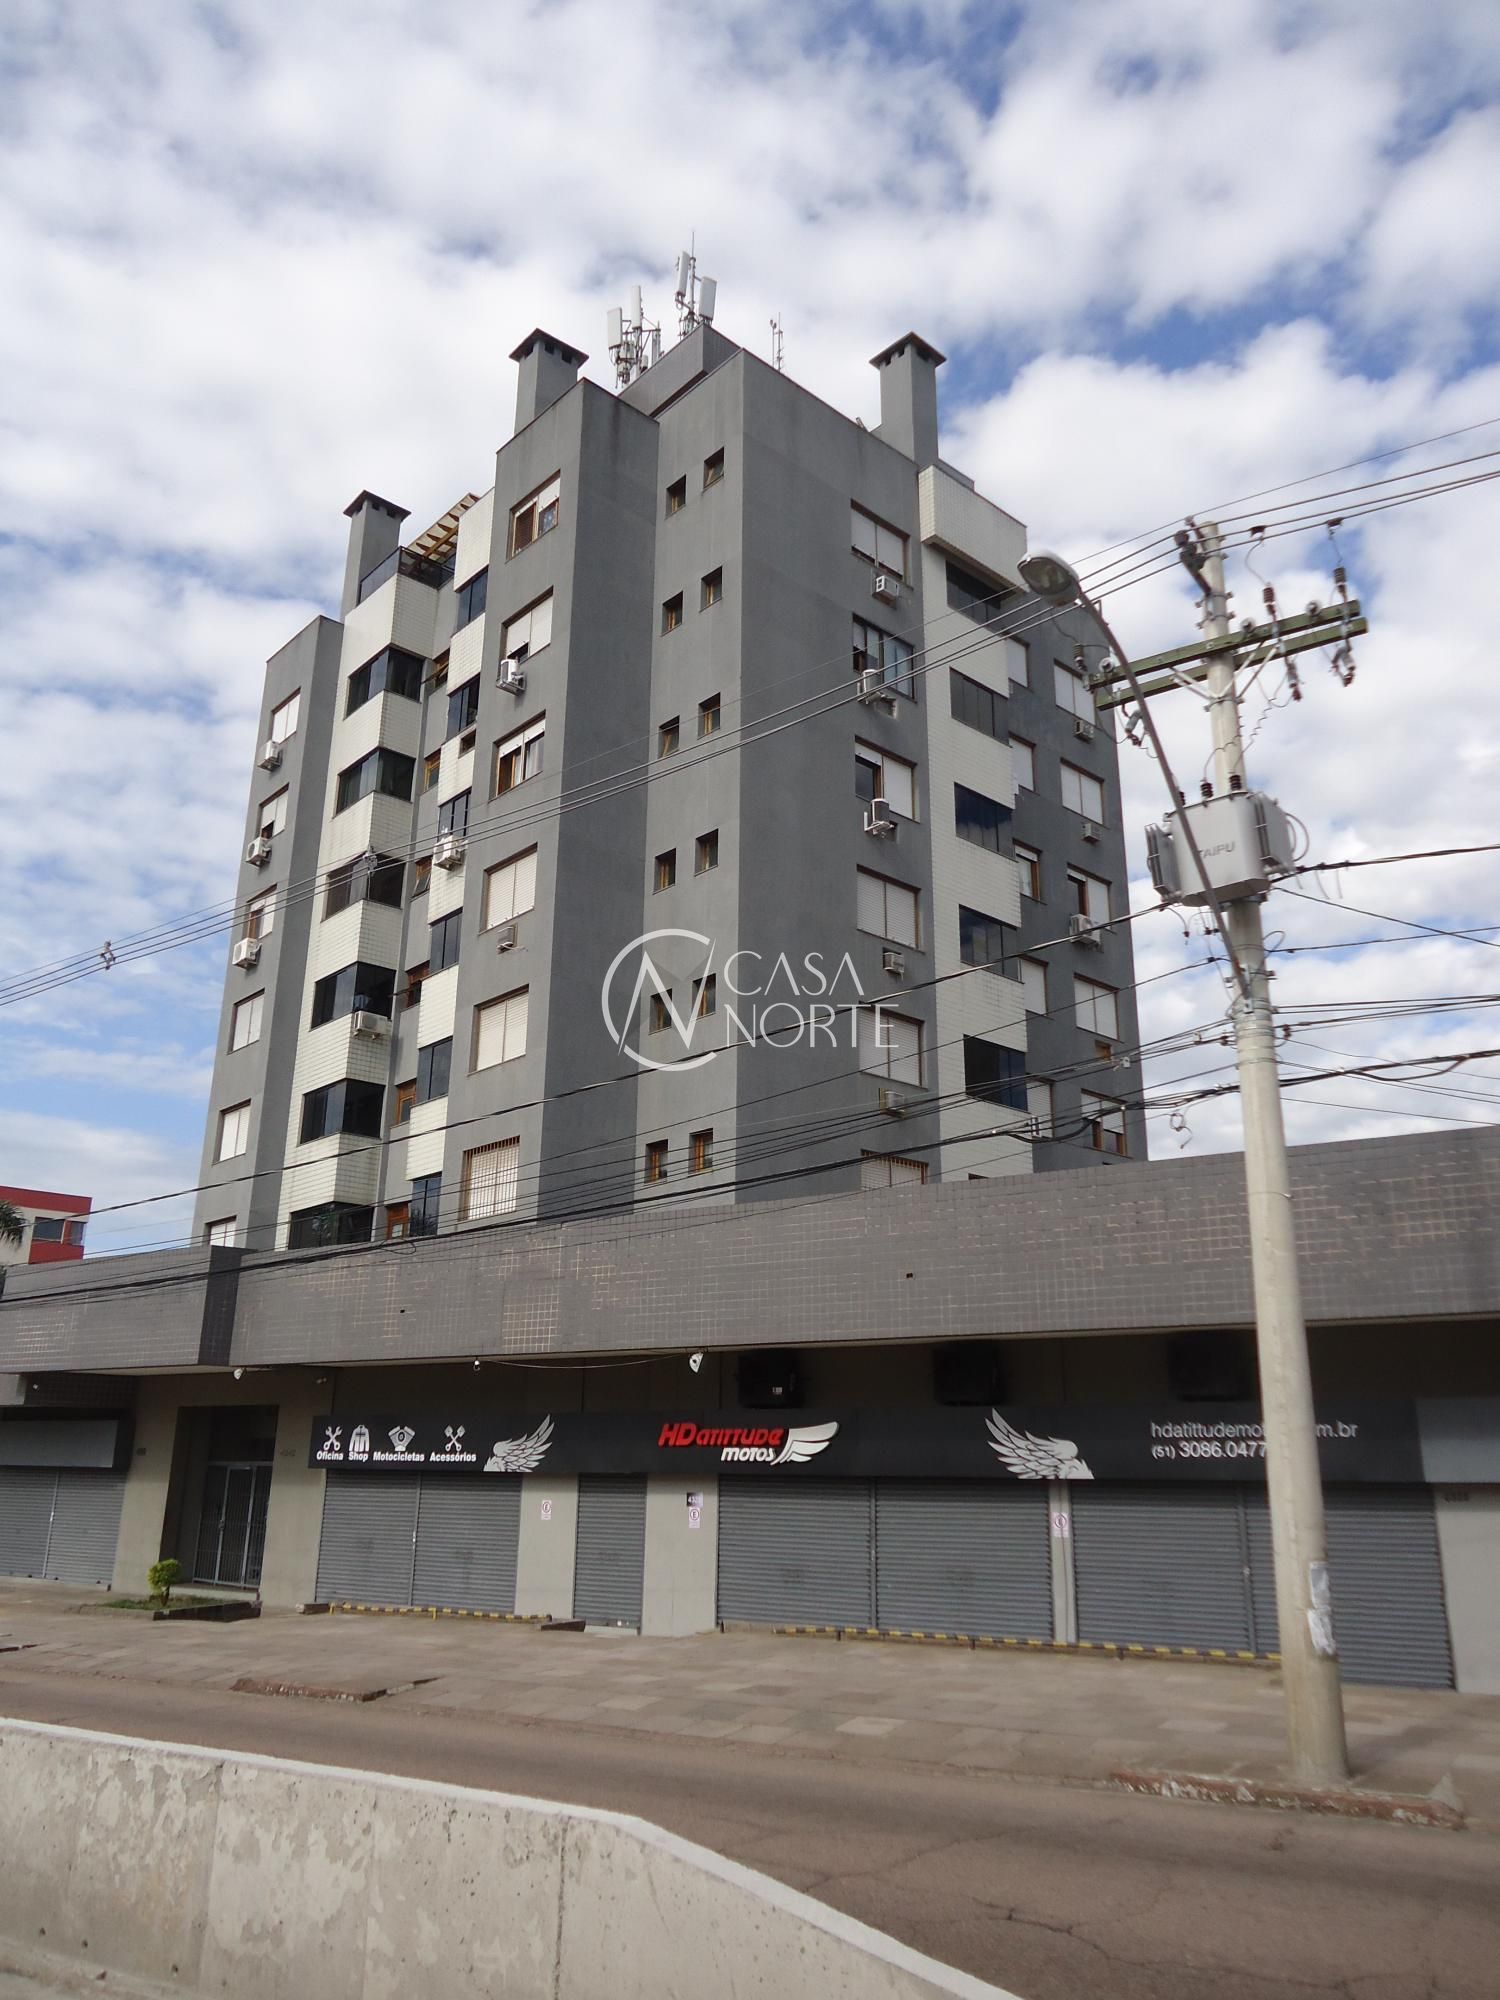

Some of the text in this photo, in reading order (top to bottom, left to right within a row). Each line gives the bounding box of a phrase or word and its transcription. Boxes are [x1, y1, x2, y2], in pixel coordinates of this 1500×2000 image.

[316, 1451, 477, 1462] Oficina Shop Motocicletas Acessórios
[1152, 1440, 1267, 1459] (51) 3086.0477
